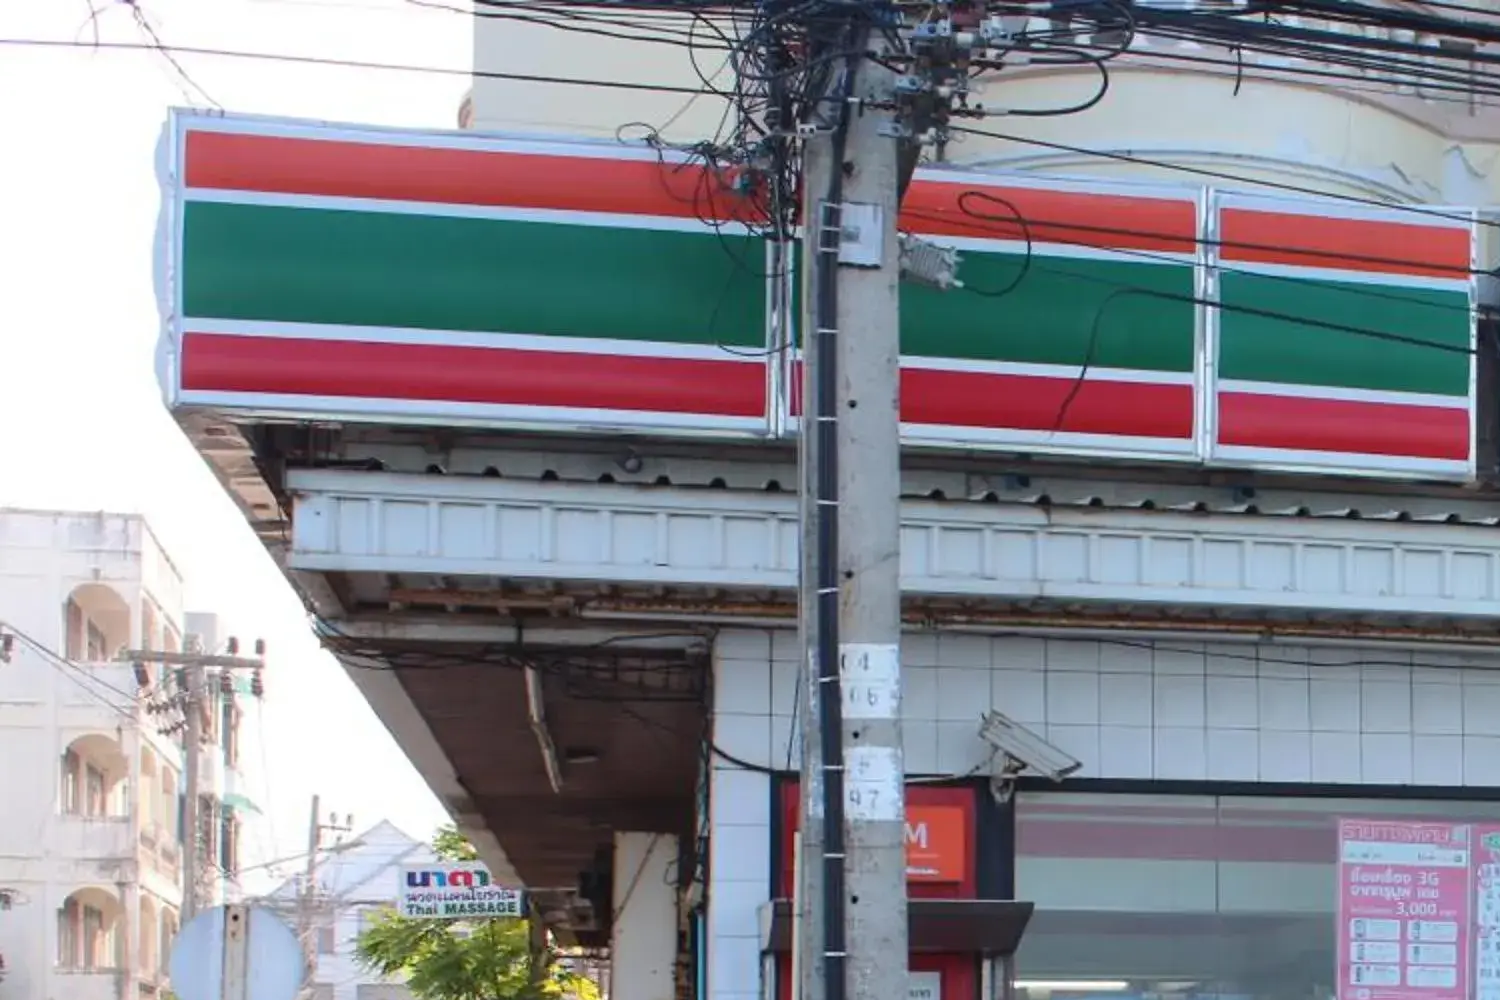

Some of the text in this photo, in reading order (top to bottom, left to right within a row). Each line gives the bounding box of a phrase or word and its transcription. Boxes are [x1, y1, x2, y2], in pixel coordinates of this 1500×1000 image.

[1417, 872, 1440, 886] 3G
[406, 902, 517, 915] Thai MASSAGE
